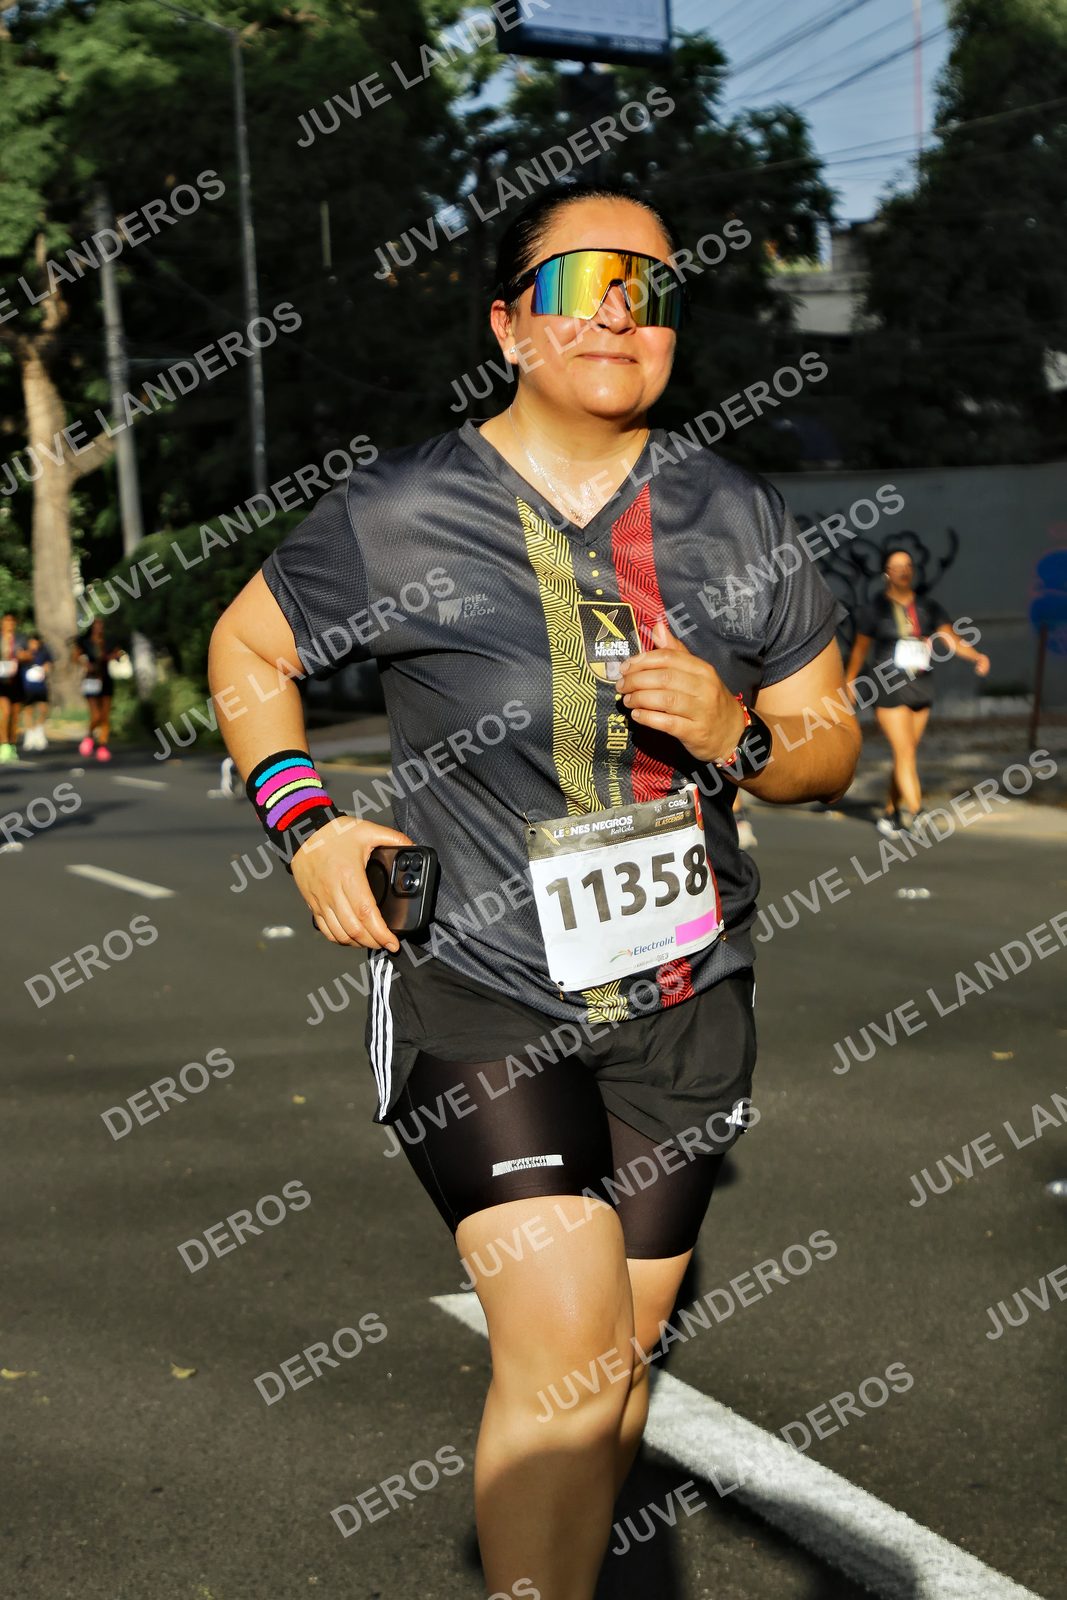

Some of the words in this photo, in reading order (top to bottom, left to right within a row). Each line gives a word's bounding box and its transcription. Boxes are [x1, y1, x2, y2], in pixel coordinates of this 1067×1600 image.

[464, 593, 488, 604] PIEL
[464, 602, 479, 611] DE
[595, 648, 630, 656] NEGROS
[592, 815, 633, 832] NEGROS
[545, 843, 708, 931] 11358
[633, 936, 675, 956] Electrolit
